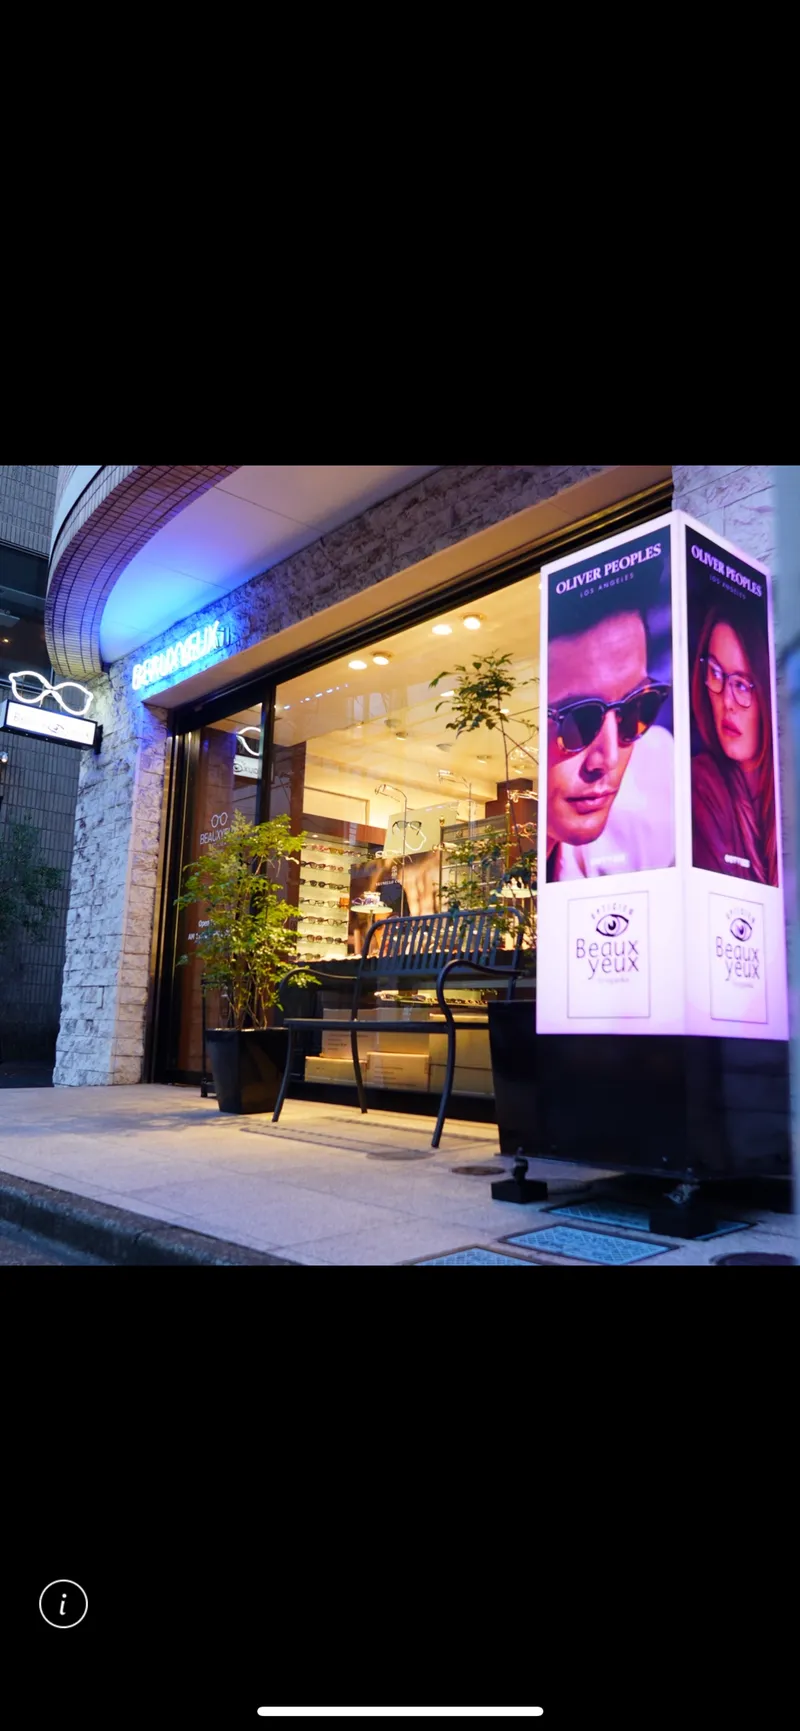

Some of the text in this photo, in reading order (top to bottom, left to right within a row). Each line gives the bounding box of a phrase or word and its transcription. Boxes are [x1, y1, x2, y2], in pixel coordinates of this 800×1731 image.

[556, 543, 661, 594] OLIVER PEOPLES
[691, 545, 762, 597] OLIVER PEOPLES
[580, 572, 634, 598] LOS ANGELES
[576, 938, 639, 959] Beaux
[716, 936, 760, 963] Beaux
[587, 956, 639, 980] yeux
[725, 960, 760, 982] yeux
